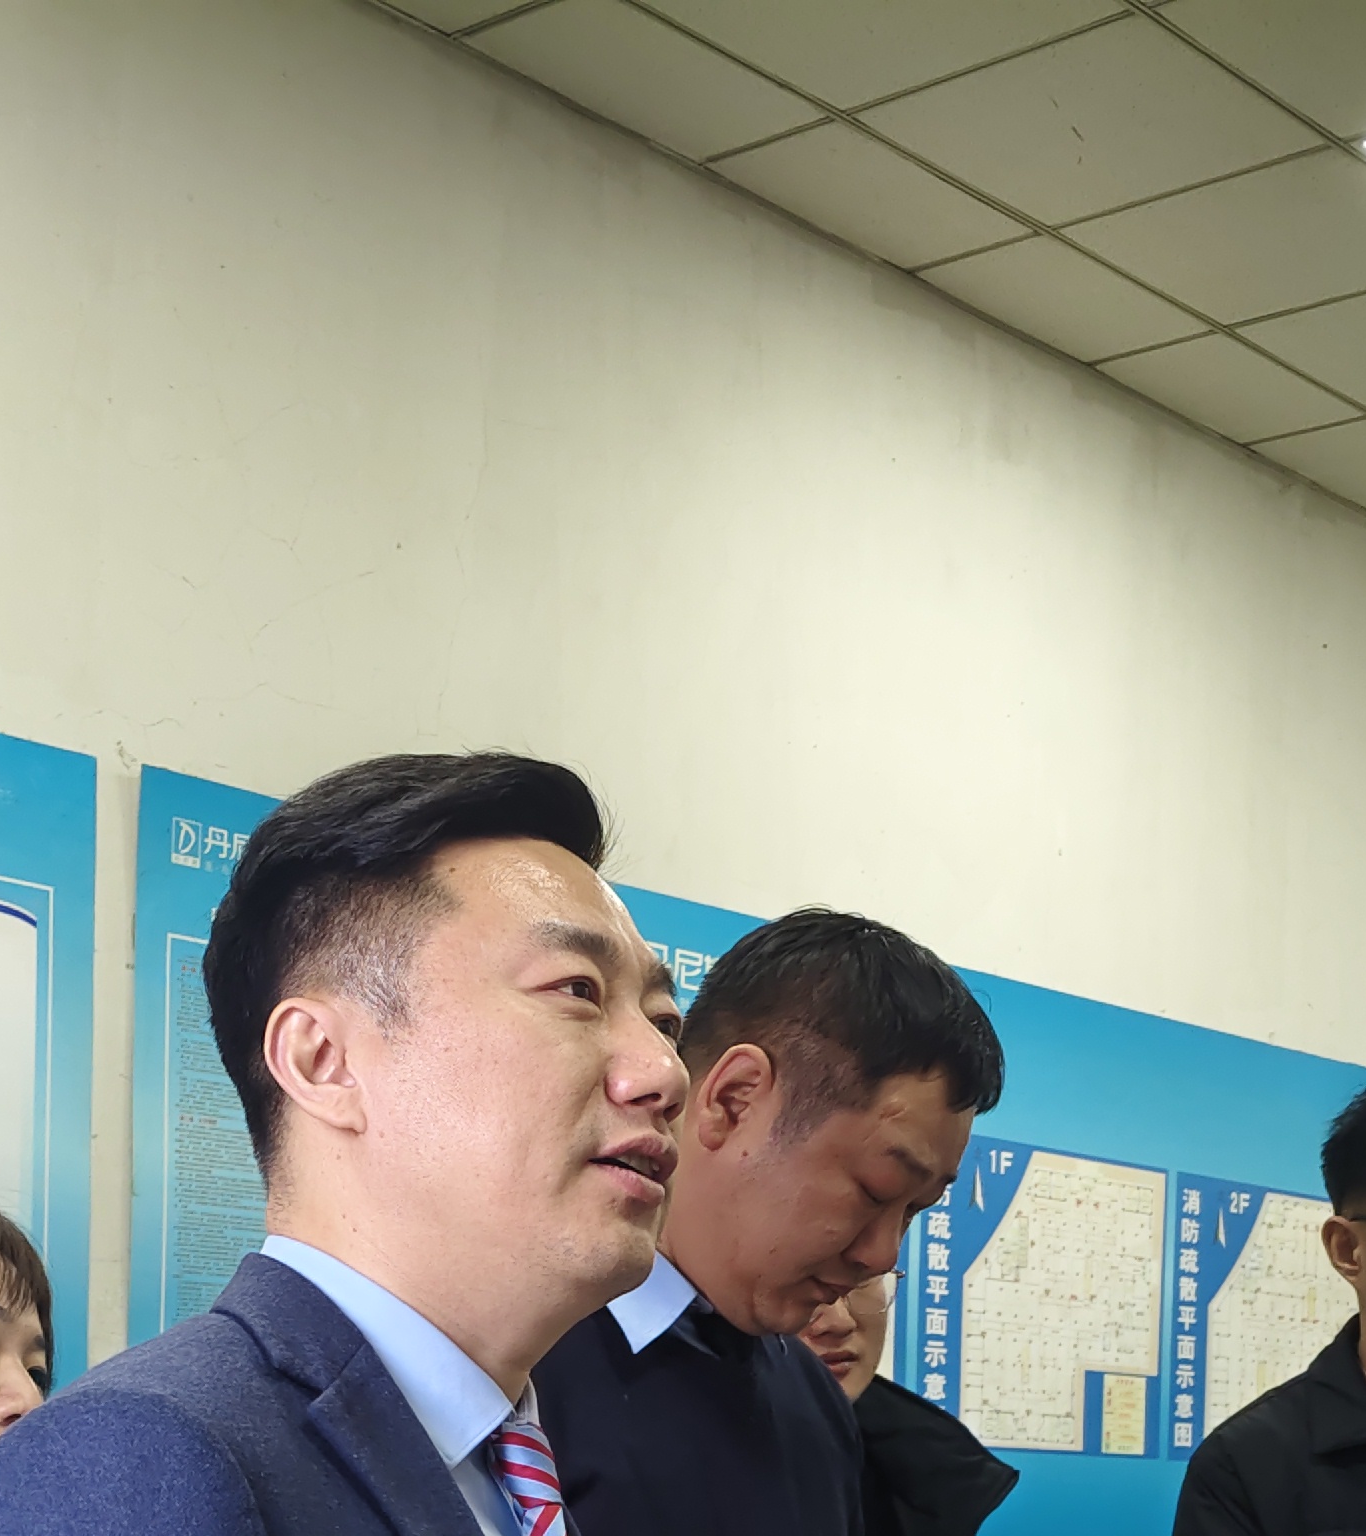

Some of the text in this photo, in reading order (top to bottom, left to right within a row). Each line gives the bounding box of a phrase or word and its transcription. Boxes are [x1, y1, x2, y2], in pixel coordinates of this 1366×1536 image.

[990, 1150, 1014, 1175] 1F
[1229, 1191, 1251, 1214] 2F
[923, 1184, 952, 1410] 疏散平面示意
[1174, 1188, 1201, 1448] 消防疏散平面示意图
